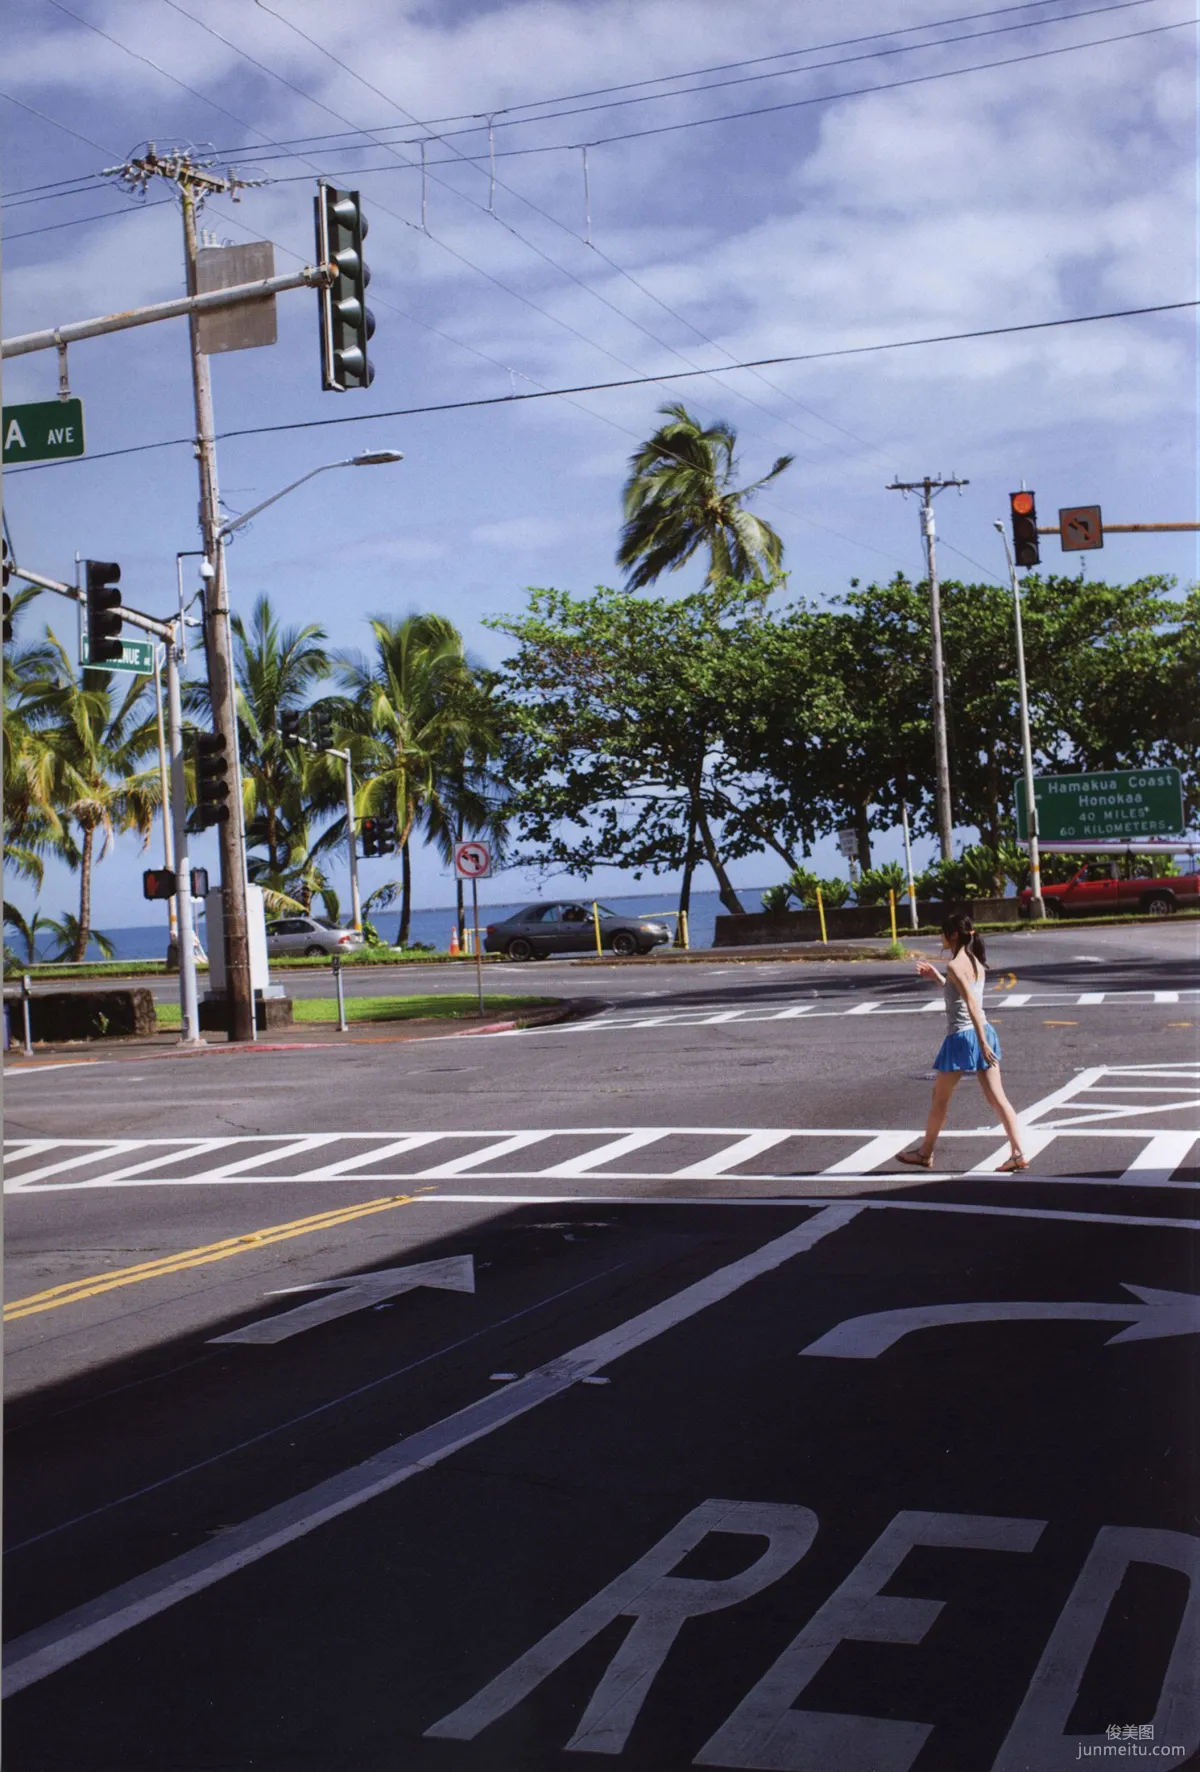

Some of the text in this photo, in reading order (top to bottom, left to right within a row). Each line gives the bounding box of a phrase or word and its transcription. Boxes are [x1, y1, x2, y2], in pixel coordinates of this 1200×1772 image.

[47, 427, 75, 445] AVE
[1048, 774, 1173, 794] Hamakua Coast
[1078, 793, 1143, 807] Honokaa
[1078, 808, 1146, 821] 40 MILES
[1060, 820, 1166, 836] 60 KILOMETERS
[422, 1498, 1200, 1772] RED
